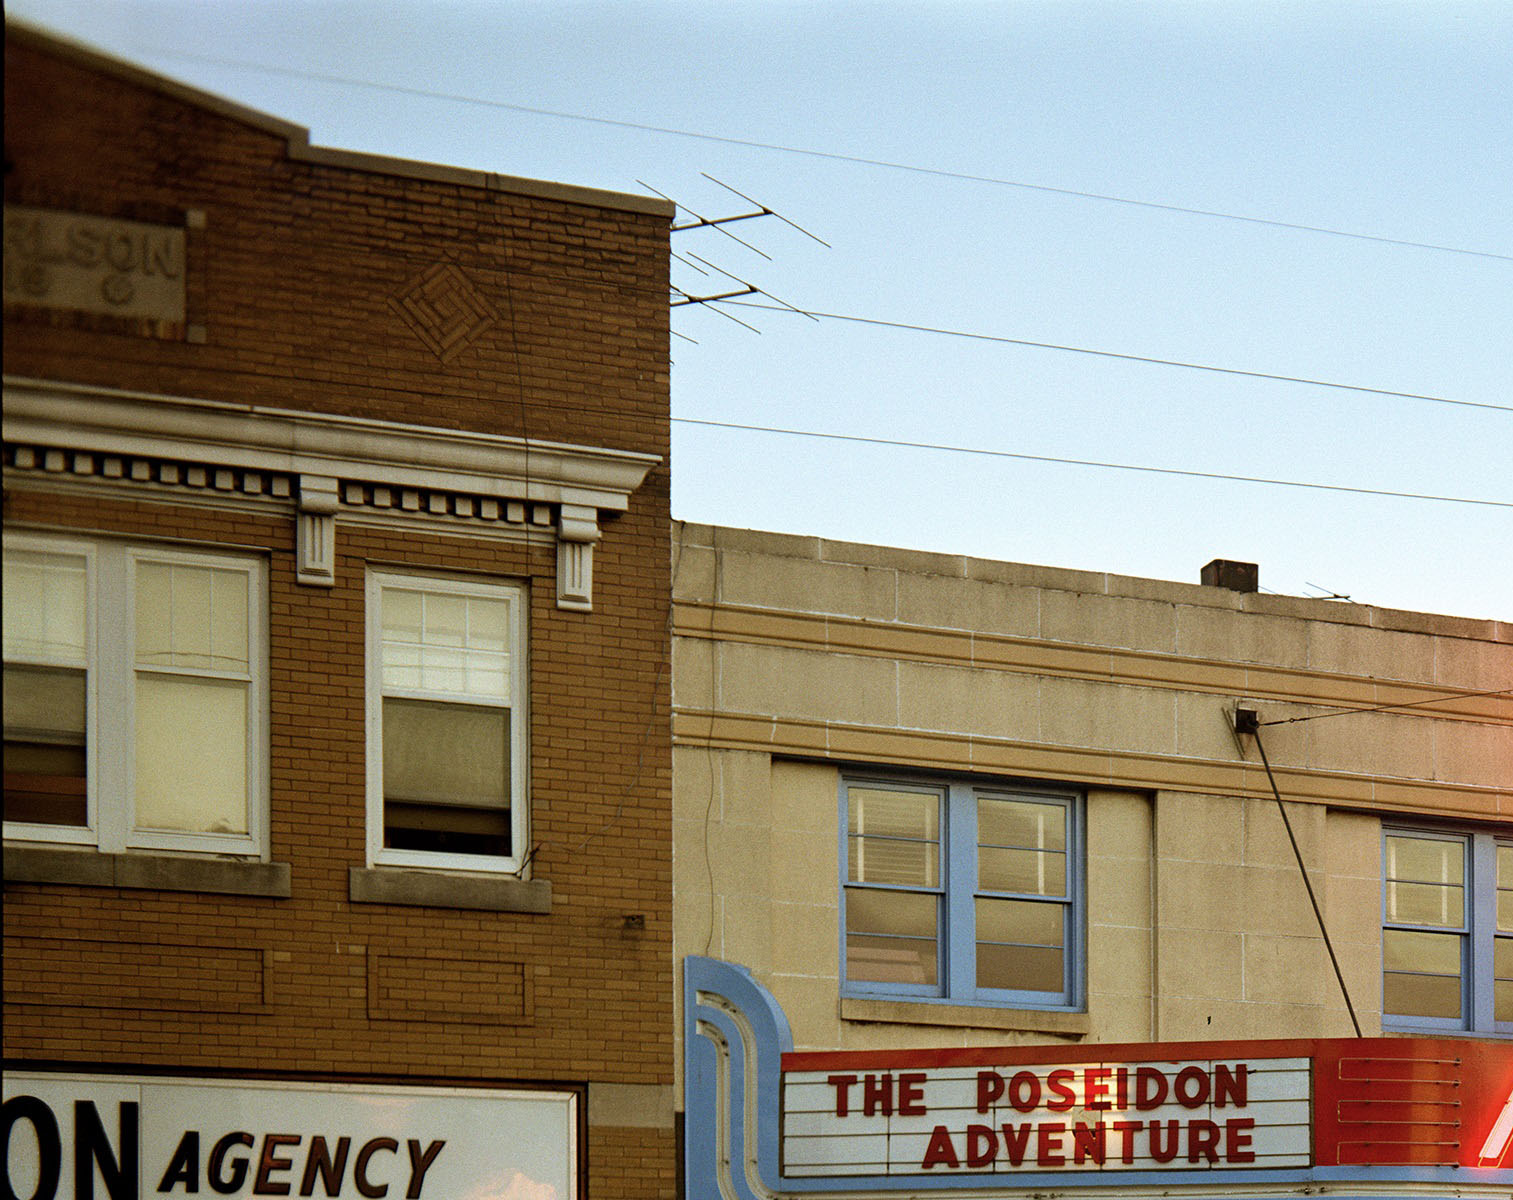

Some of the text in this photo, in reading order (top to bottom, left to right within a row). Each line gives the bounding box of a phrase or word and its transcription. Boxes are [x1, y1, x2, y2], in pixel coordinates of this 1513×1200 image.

[828, 1064, 1248, 1117] THE POSEIDON
[157, 1131, 446, 1200] AGENCY
[922, 1118, 1255, 1169] ADVENTURE
